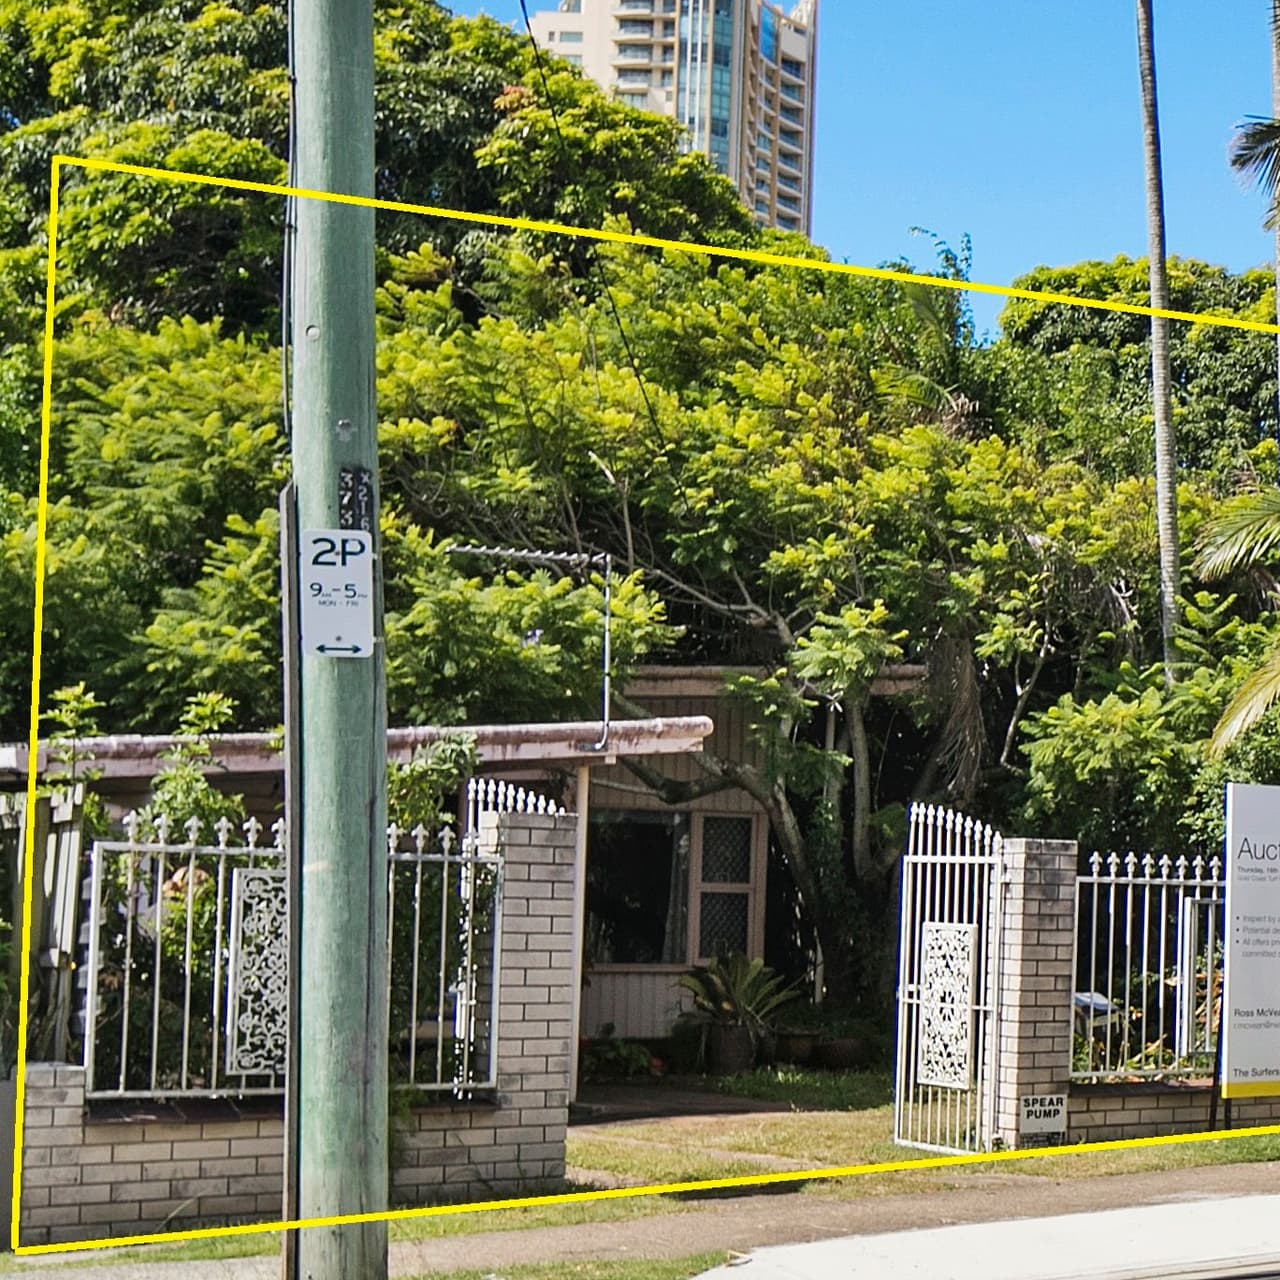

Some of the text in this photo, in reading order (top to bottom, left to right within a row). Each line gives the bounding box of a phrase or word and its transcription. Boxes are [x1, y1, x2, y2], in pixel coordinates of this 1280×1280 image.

[339, 472, 353, 526] 373
[311, 537, 366, 567] 2P
[318, 599, 337, 607] MON
[1242, 915, 1267, 923] Inspect
[1267, 916, 1276, 924] by
[1242, 927, 1270, 935] Potential
[1234, 1008, 1255, 1017] Ross
[1234, 1068, 1249, 1078] The
[1250, 1067, 1280, 1077] Surfers
[1023, 1097, 1064, 1108] SPEAR
[1026, 1108, 1060, 1119] PUMP
